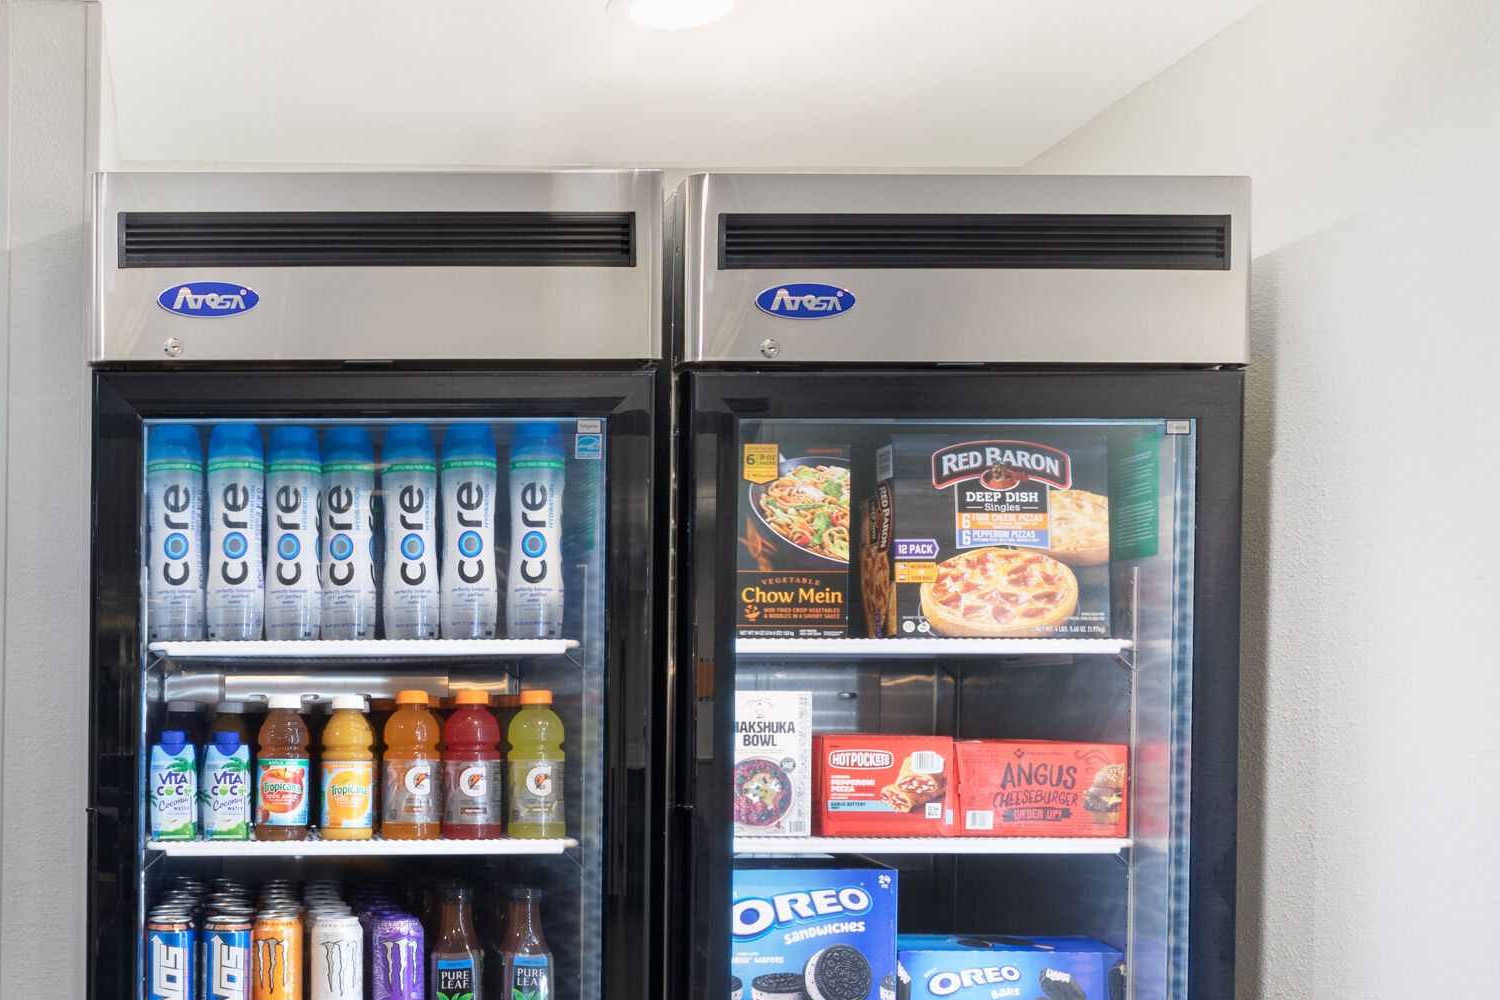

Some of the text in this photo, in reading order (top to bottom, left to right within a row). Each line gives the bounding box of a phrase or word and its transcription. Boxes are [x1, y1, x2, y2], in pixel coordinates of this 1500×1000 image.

[746, 454, 756, 465] 6
[942, 446, 1061, 478] RED BARON
[966, 492, 1039, 504] DEEP DISH
[985, 503, 1021, 513] Singles
[878, 486, 890, 549] RED BARON
[962, 514, 971, 529] 6
[991, 514, 1017, 523] CHEESE
[1018, 514, 1043, 523] PIZZAS
[163, 484, 191, 586] core
[221, 482, 249, 586] core
[276, 485, 301, 586] core
[328, 484, 354, 586] core
[399, 484, 426, 586] core
[457, 481, 484, 584] core
[521, 482, 547, 584] core
[962, 530, 971, 545] 6
[972, 531, 1009, 539] PEPPERONI
[1011, 531, 1036, 540] PIZZAS
[898, 544, 933, 554] 12 PACK
[761, 576, 821, 586] VEGETABLE
[741, 586, 843, 604] Chow Mein
[743, 735, 778, 747] BOWL
[159, 770, 188, 785] VITA
[213, 770, 242, 785] VITA
[1001, 761, 1077, 790] ANGUS
[263, 780, 302, 794] Tropicana
[330, 784, 367, 796] Tropicana
[992, 789, 1078, 808] CHEESEBURGER
[1013, 808, 1062, 820] ORDER UP!
[878, 875, 891, 885] 24
[732, 887, 869, 936] OREO
[441, 971, 469, 980] PURE
[516, 968, 545, 977] PURE
[441, 980, 469, 989] LEAF
[928, 966, 1021, 996] OREO
